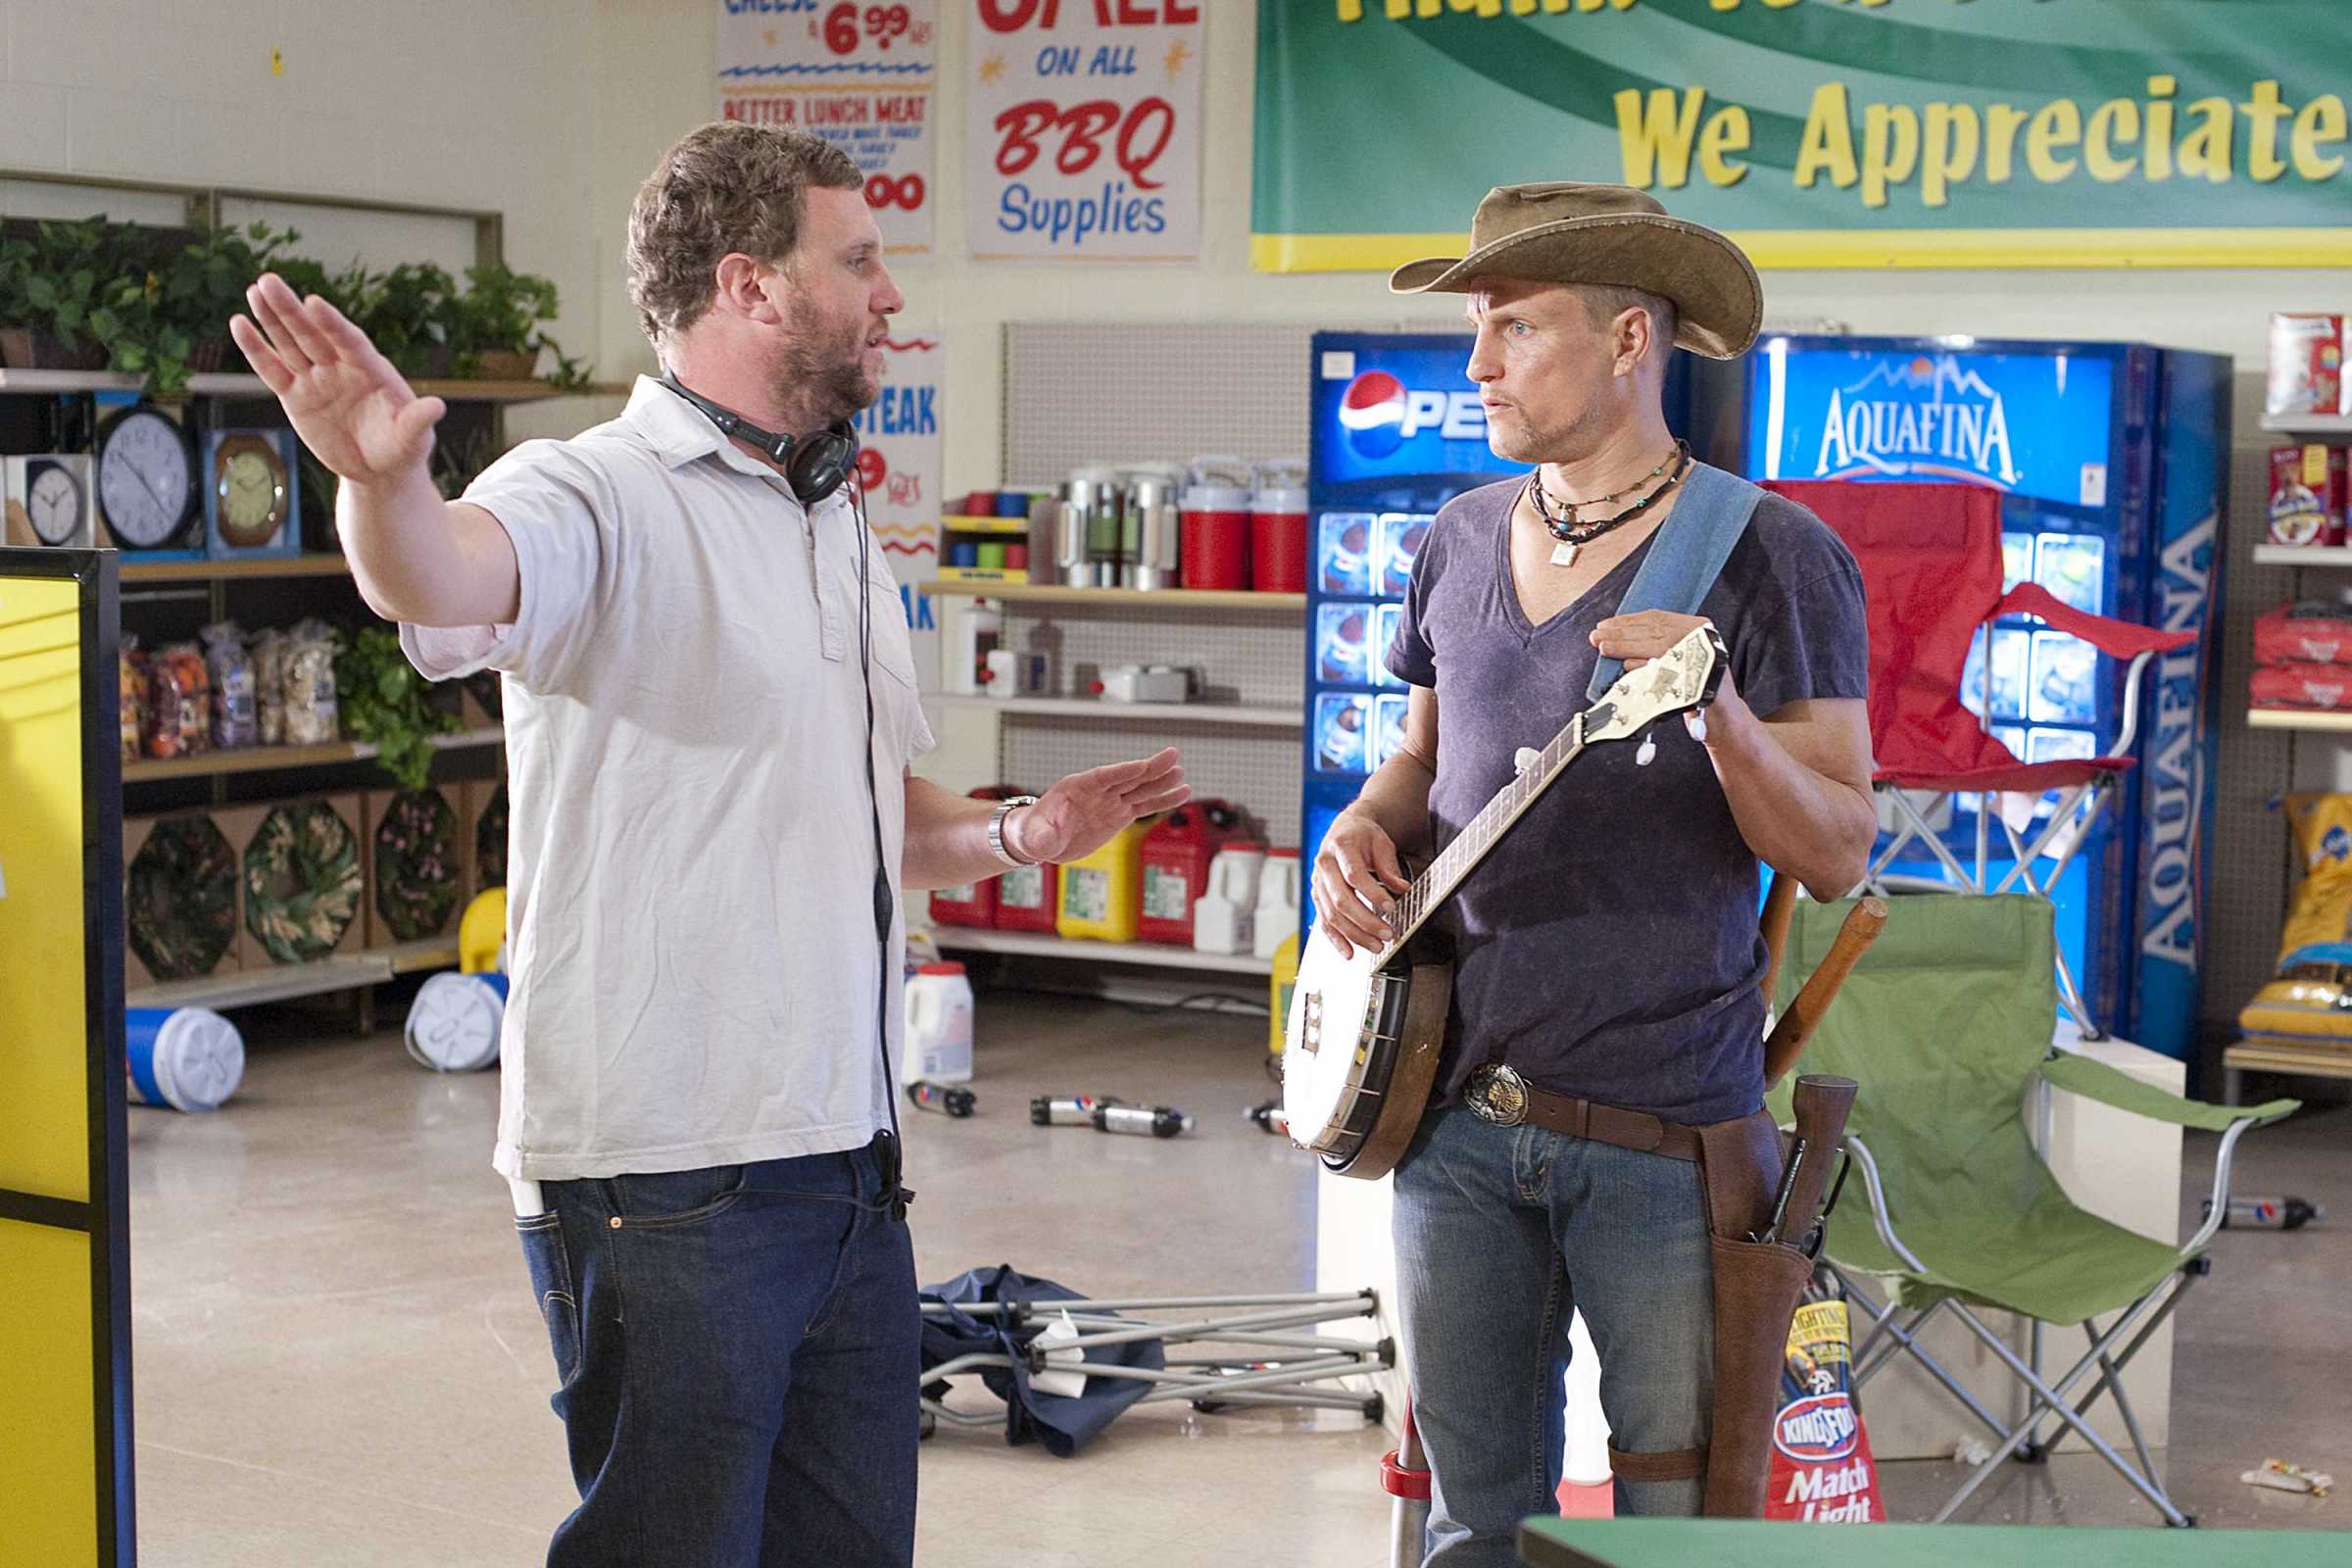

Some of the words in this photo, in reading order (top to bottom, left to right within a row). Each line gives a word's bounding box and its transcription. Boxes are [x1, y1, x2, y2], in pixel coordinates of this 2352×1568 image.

[1036, 46, 1081, 76] ON
[1088, 45, 1138, 76] ALL
[874, 96, 926, 122] MEAT
[994, 96, 1176, 190] BBQ
[1614, 86, 1751, 188] We
[1793, 74, 2348, 209] Appreciate
[997, 181, 1166, 244] Supplies
[1814, 387, 2018, 485] AQUAFINA
[2142, 512, 2219, 973] AQUAFINA
[1782, 1405, 1855, 1449] KINGSFO
[1784, 1456, 1870, 1504] Match
